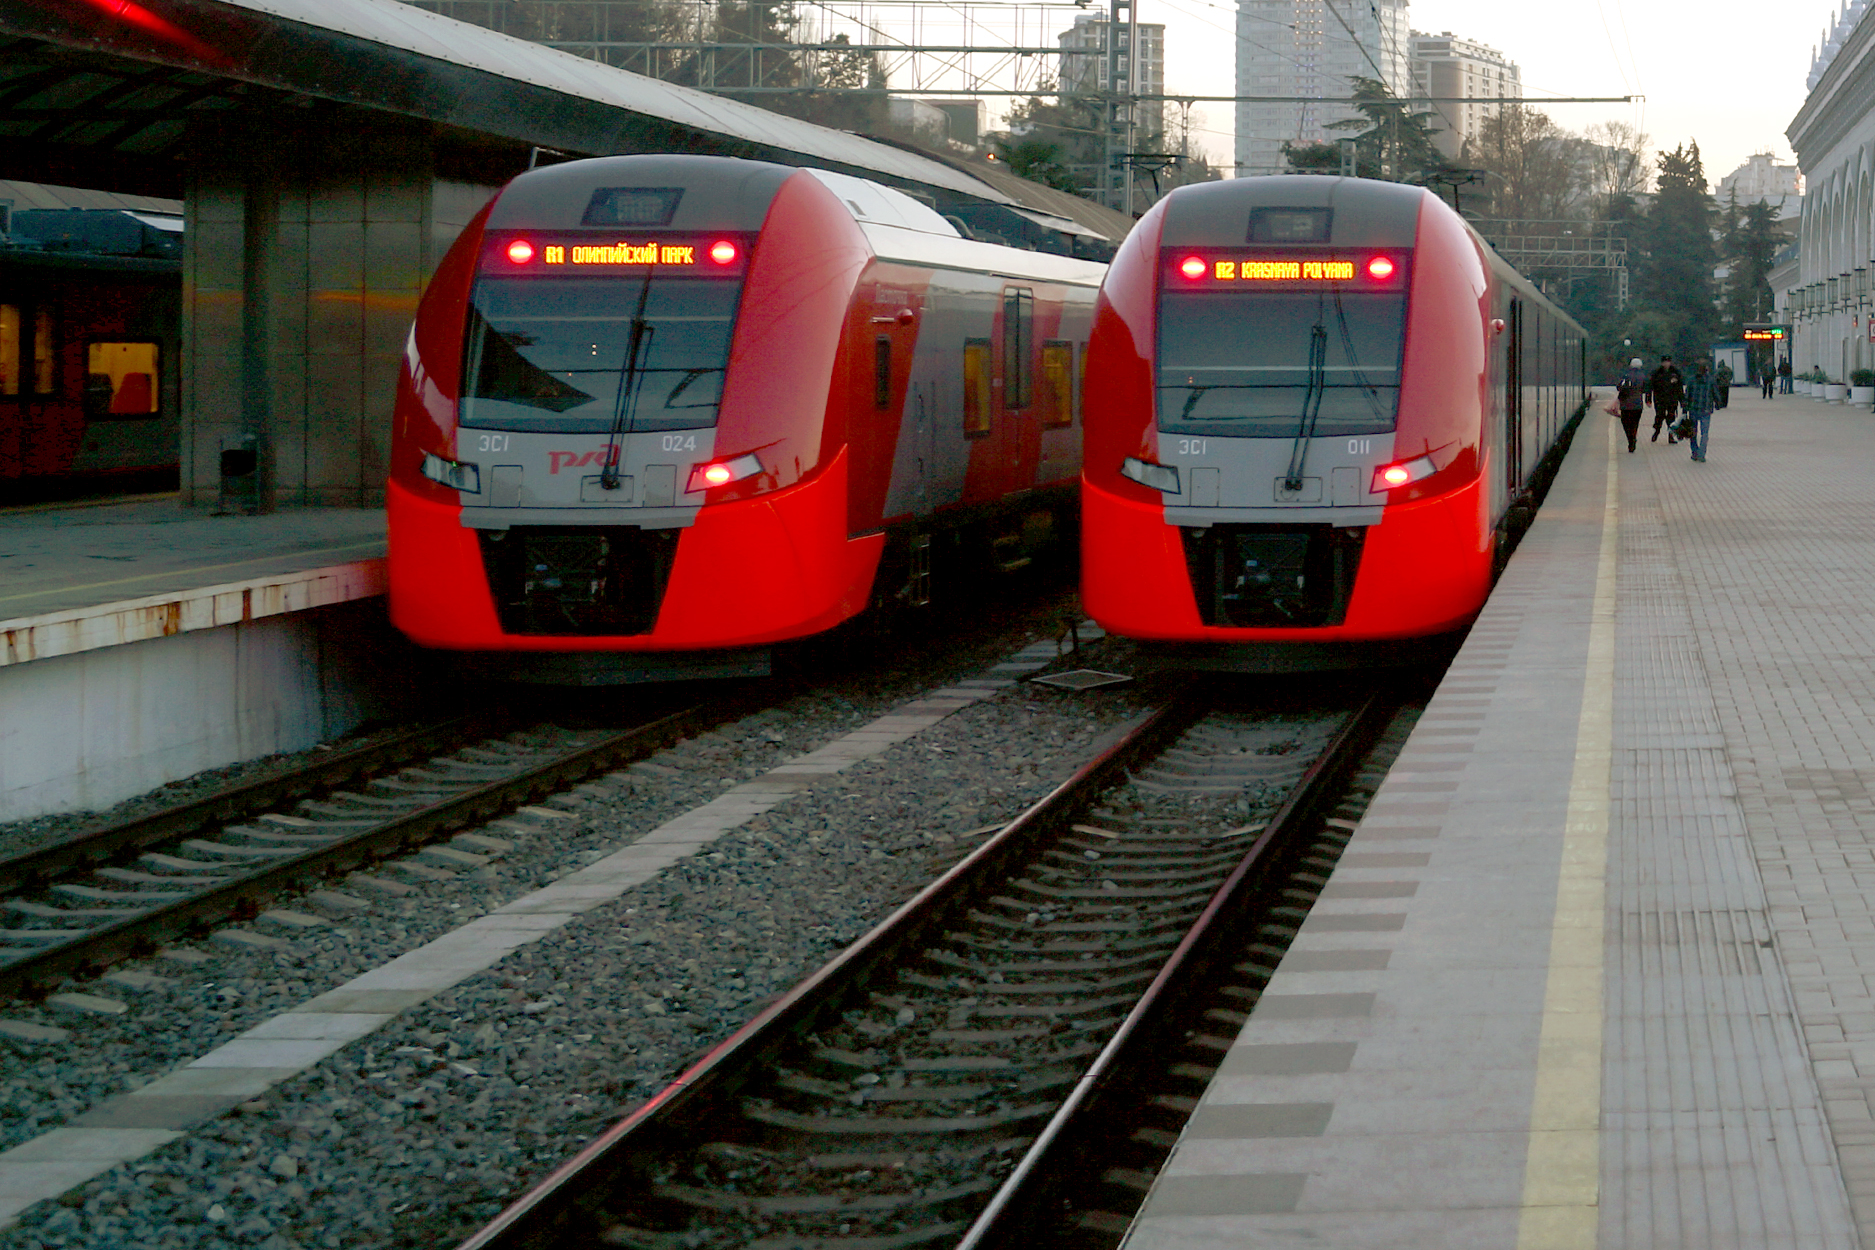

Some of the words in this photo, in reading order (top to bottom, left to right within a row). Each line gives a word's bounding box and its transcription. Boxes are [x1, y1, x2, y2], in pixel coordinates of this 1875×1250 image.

[571, 242, 658, 264] ОЛИМПИЙСКИЙ
[660, 246, 694, 264] ПАРК
[1240, 261, 1300, 280] KRASNAYA
[1301, 261, 1354, 280] POLYANA
[662, 435, 697, 452] 024
[1347, 439, 1370, 455] 011
